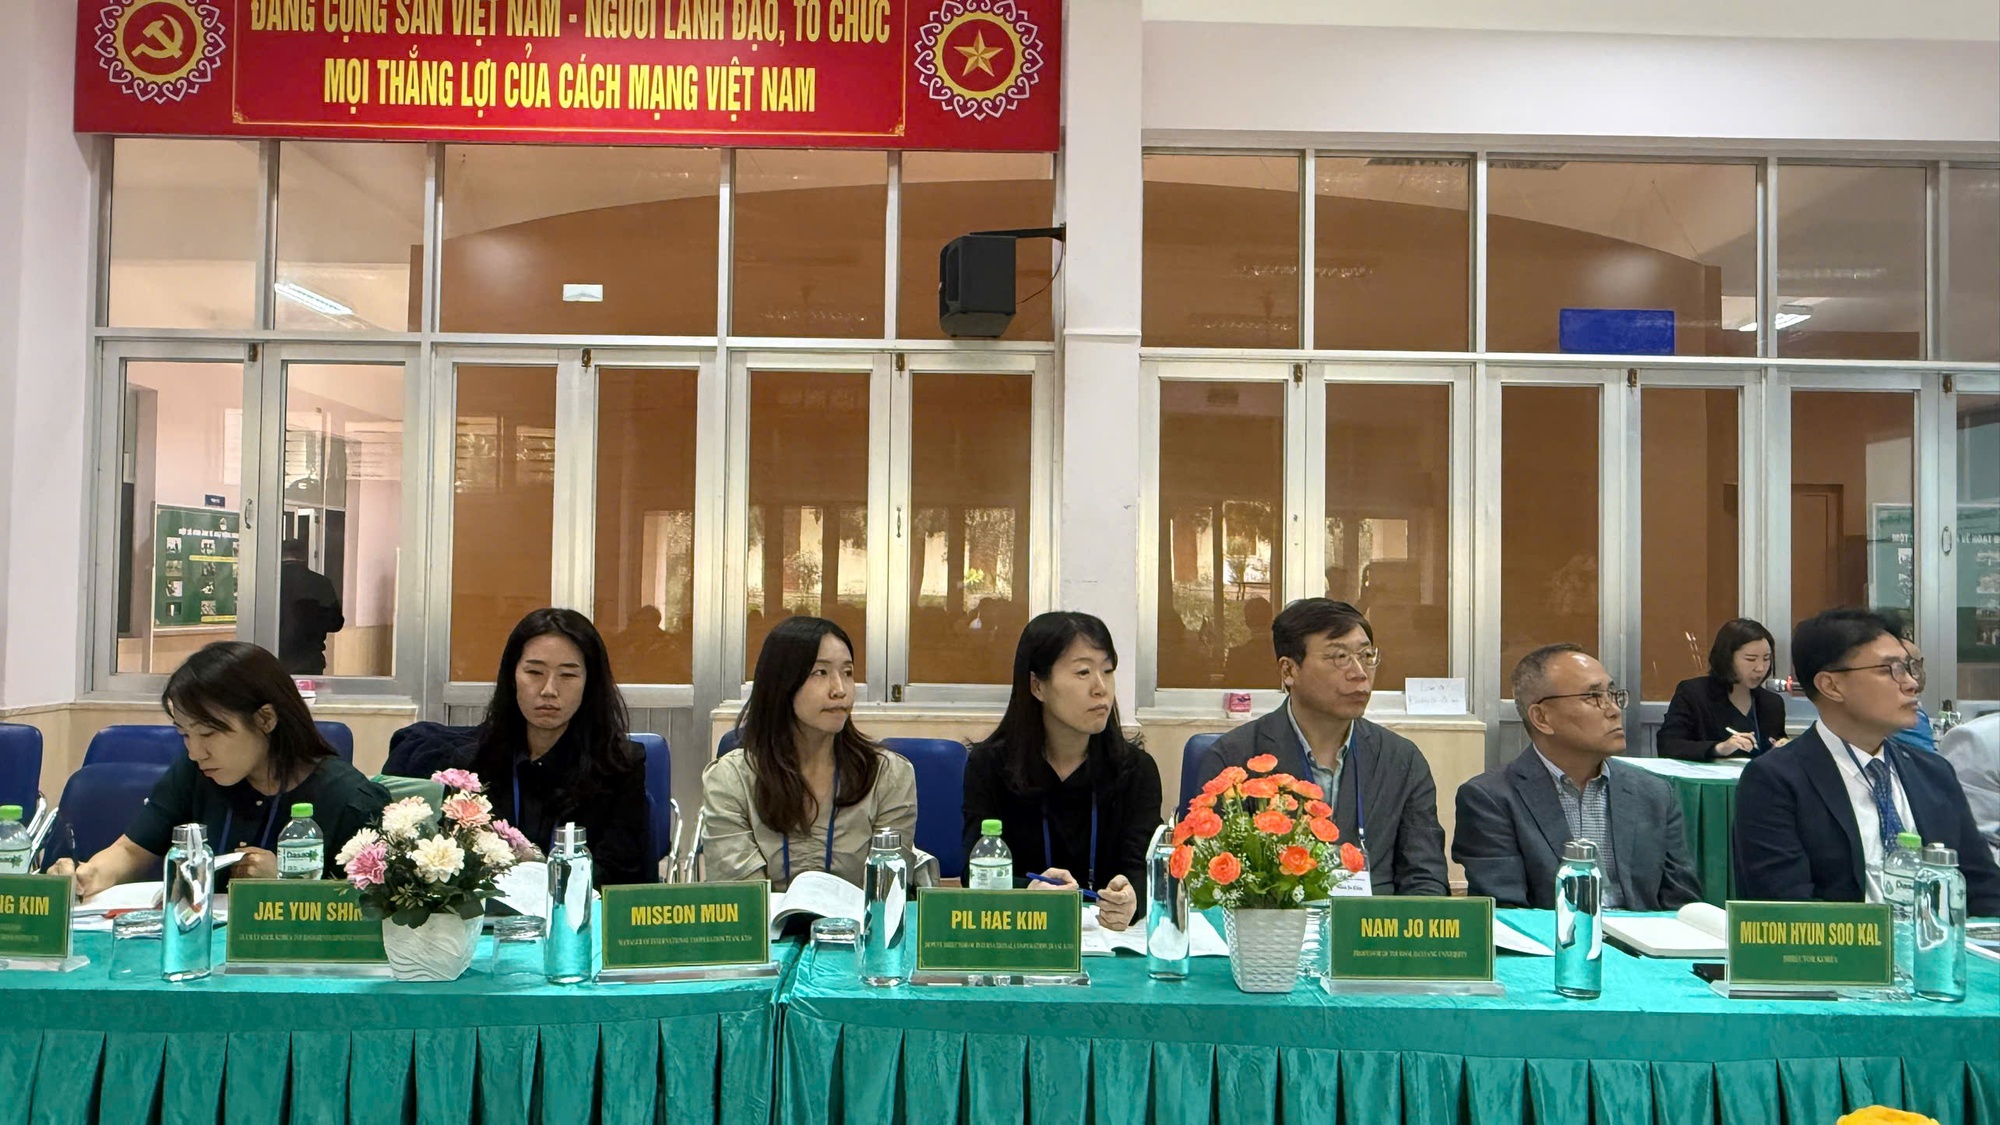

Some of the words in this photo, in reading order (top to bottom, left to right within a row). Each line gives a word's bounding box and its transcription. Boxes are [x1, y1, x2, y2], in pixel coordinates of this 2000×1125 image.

[506, 0, 561, 37] NAM
[324, 58, 370, 114] MỌI
[377, 45, 453, 107] THẮNG
[461, 58, 497, 118] LỢI
[504, 42, 551, 108] CỦA
[559, 53, 621, 109] CÁCH
[628, 64, 698, 120] MẠNG
[706, 56, 755, 122] VIỆT
[761, 66, 815, 112] NAM
[19, 896, 50, 916] KIM
[254, 901, 284, 921] JAE
[289, 901, 322, 921] YUN
[631, 904, 695, 926] MISEON
[700, 903, 738, 923] MUN
[951, 910, 976, 930] PIL
[980, 910, 1011, 930] HAE
[1016, 911, 1047, 930] KIM
[1361, 918, 1398, 938] NAM
[1403, 918, 1424, 938] JO
[1428, 918, 1460, 938] KIM
[1740, 920, 1787, 945] MILTON
[1790, 921, 1825, 945] HYUN
[1828, 922, 1853, 946] SOO
[1857, 923, 1881, 946] KAL
